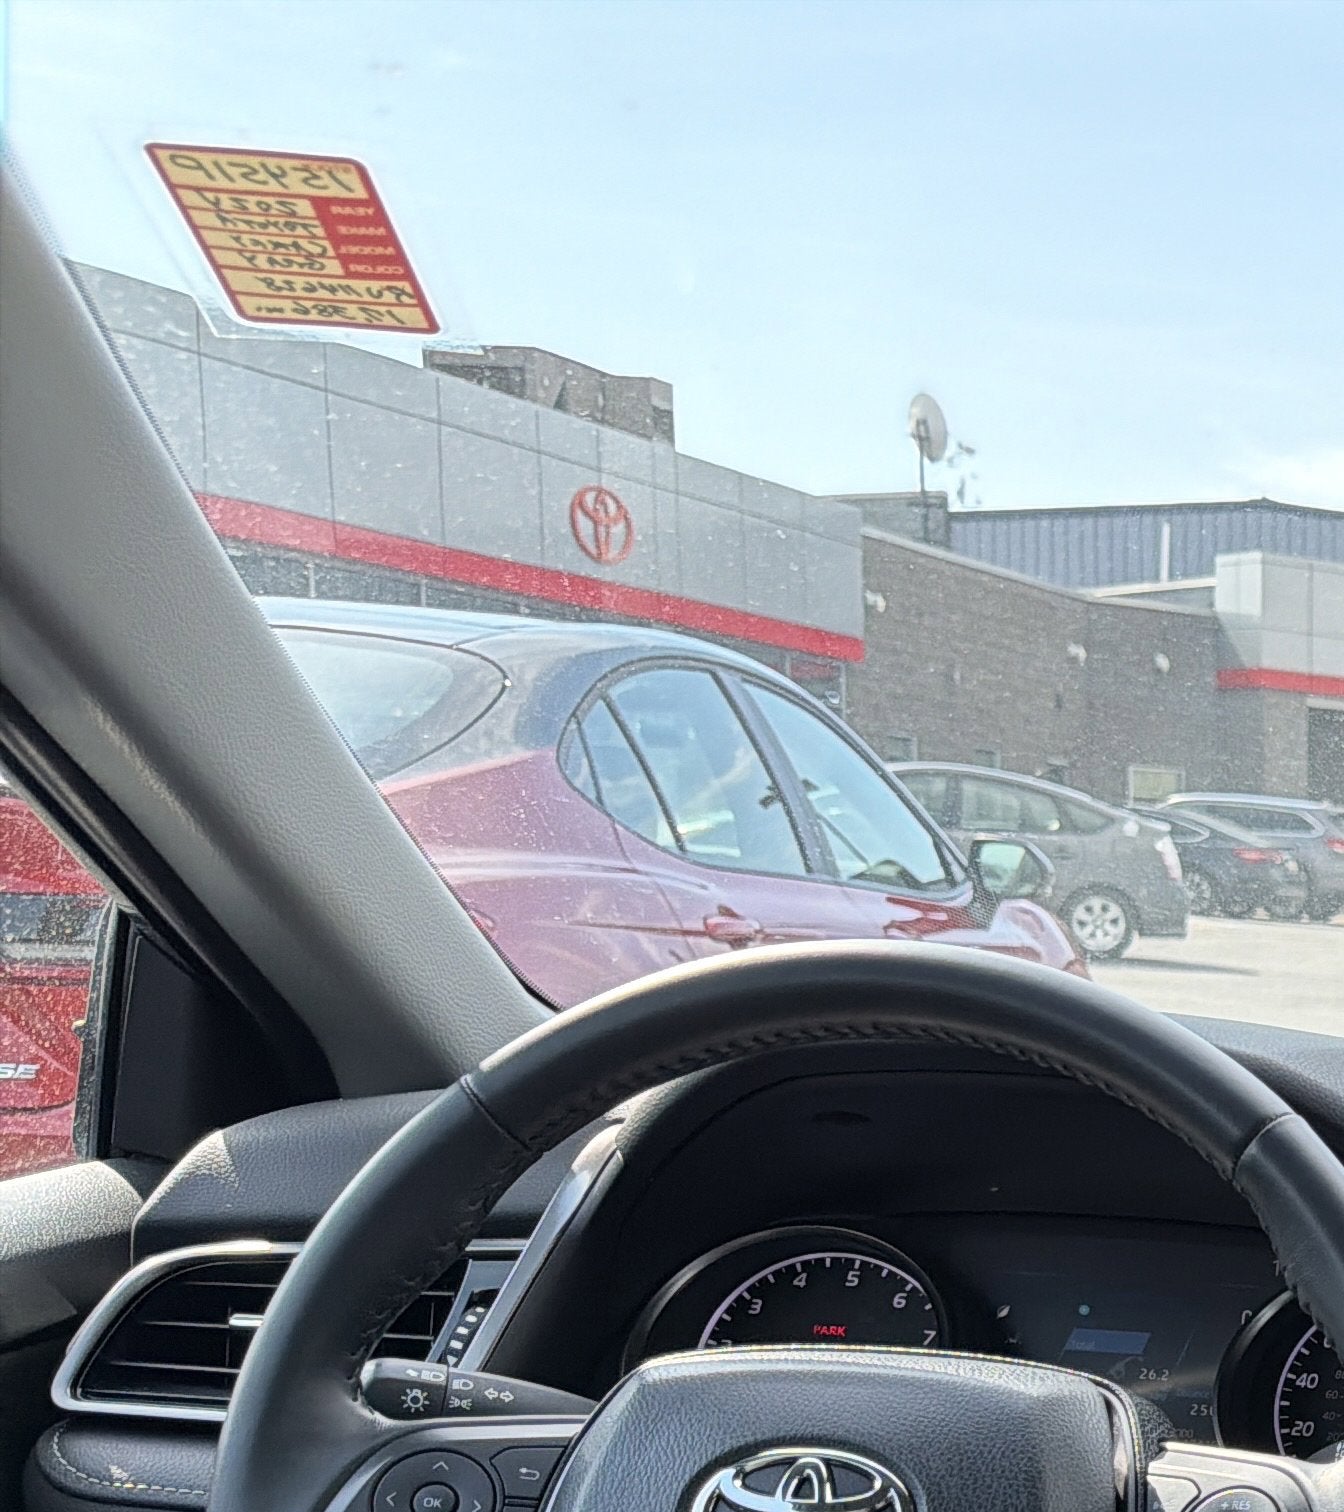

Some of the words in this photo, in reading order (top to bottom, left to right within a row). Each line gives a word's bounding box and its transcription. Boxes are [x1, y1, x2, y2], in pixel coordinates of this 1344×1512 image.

[793, 1273, 808, 1288] 4
[845, 1271, 860, 1287] 5
[748, 1299, 762, 1314] 3
[893, 1293, 907, 1308] 6
[813, 1325, 847, 1337] PARK
[923, 1330, 937, 1346] 7
[1139, 1368, 1170, 1381] 26.2
[1296, 1373, 1319, 1389] 40
[1291, 1421, 1314, 1437] 20
[423, 1497, 442, 1509] OK
[1231, 1500, 1251, 1510] RES
